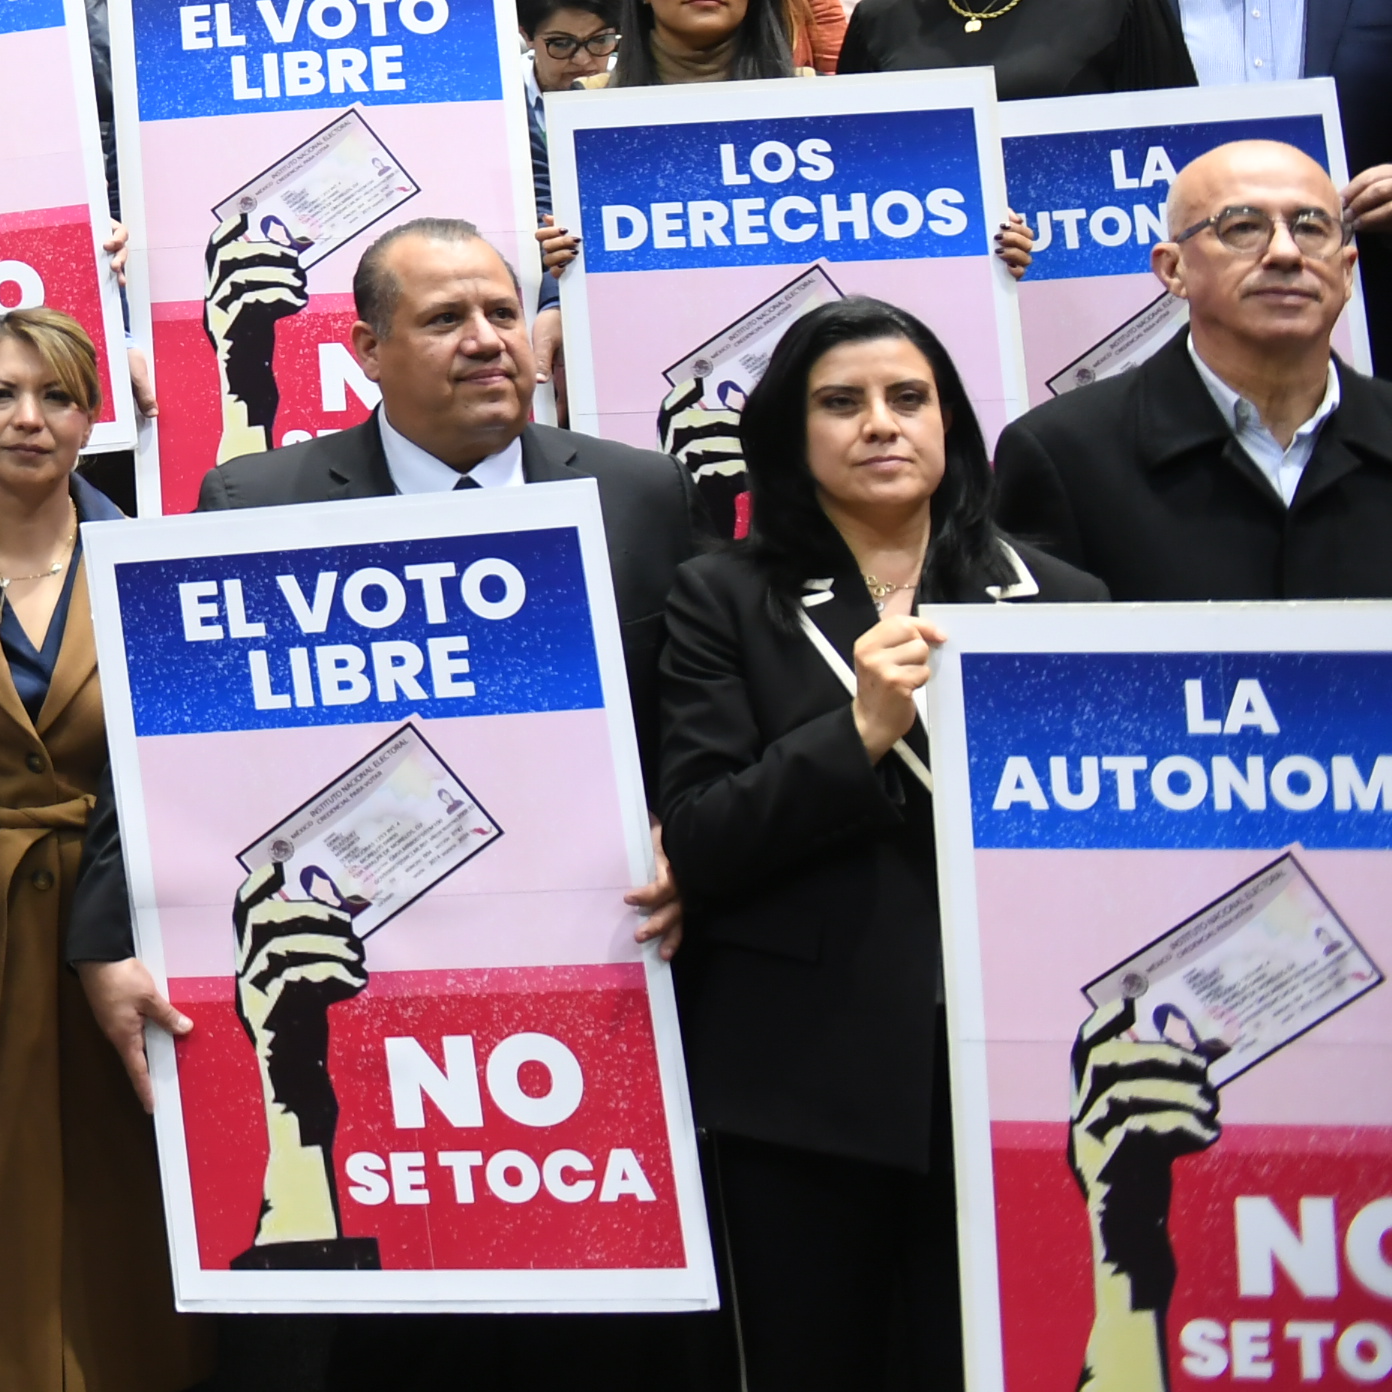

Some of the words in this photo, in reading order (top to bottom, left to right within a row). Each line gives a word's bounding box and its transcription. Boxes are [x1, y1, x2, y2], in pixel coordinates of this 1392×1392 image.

[180, 3, 246, 50] EL
[231, 45, 406, 100] LIBRE
[720, 139, 834, 185] LOS
[602, 188, 967, 251] DERECHOS
[179, 579, 266, 641] EL
[276, 558, 526, 633] VOTO
[249, 636, 475, 710] LIBRE
[1185, 680, 1280, 734] LA
[385, 1033, 583, 1128] NO
[346, 1152, 430, 1205] SE
[438, 1149, 656, 1203] TOCA
